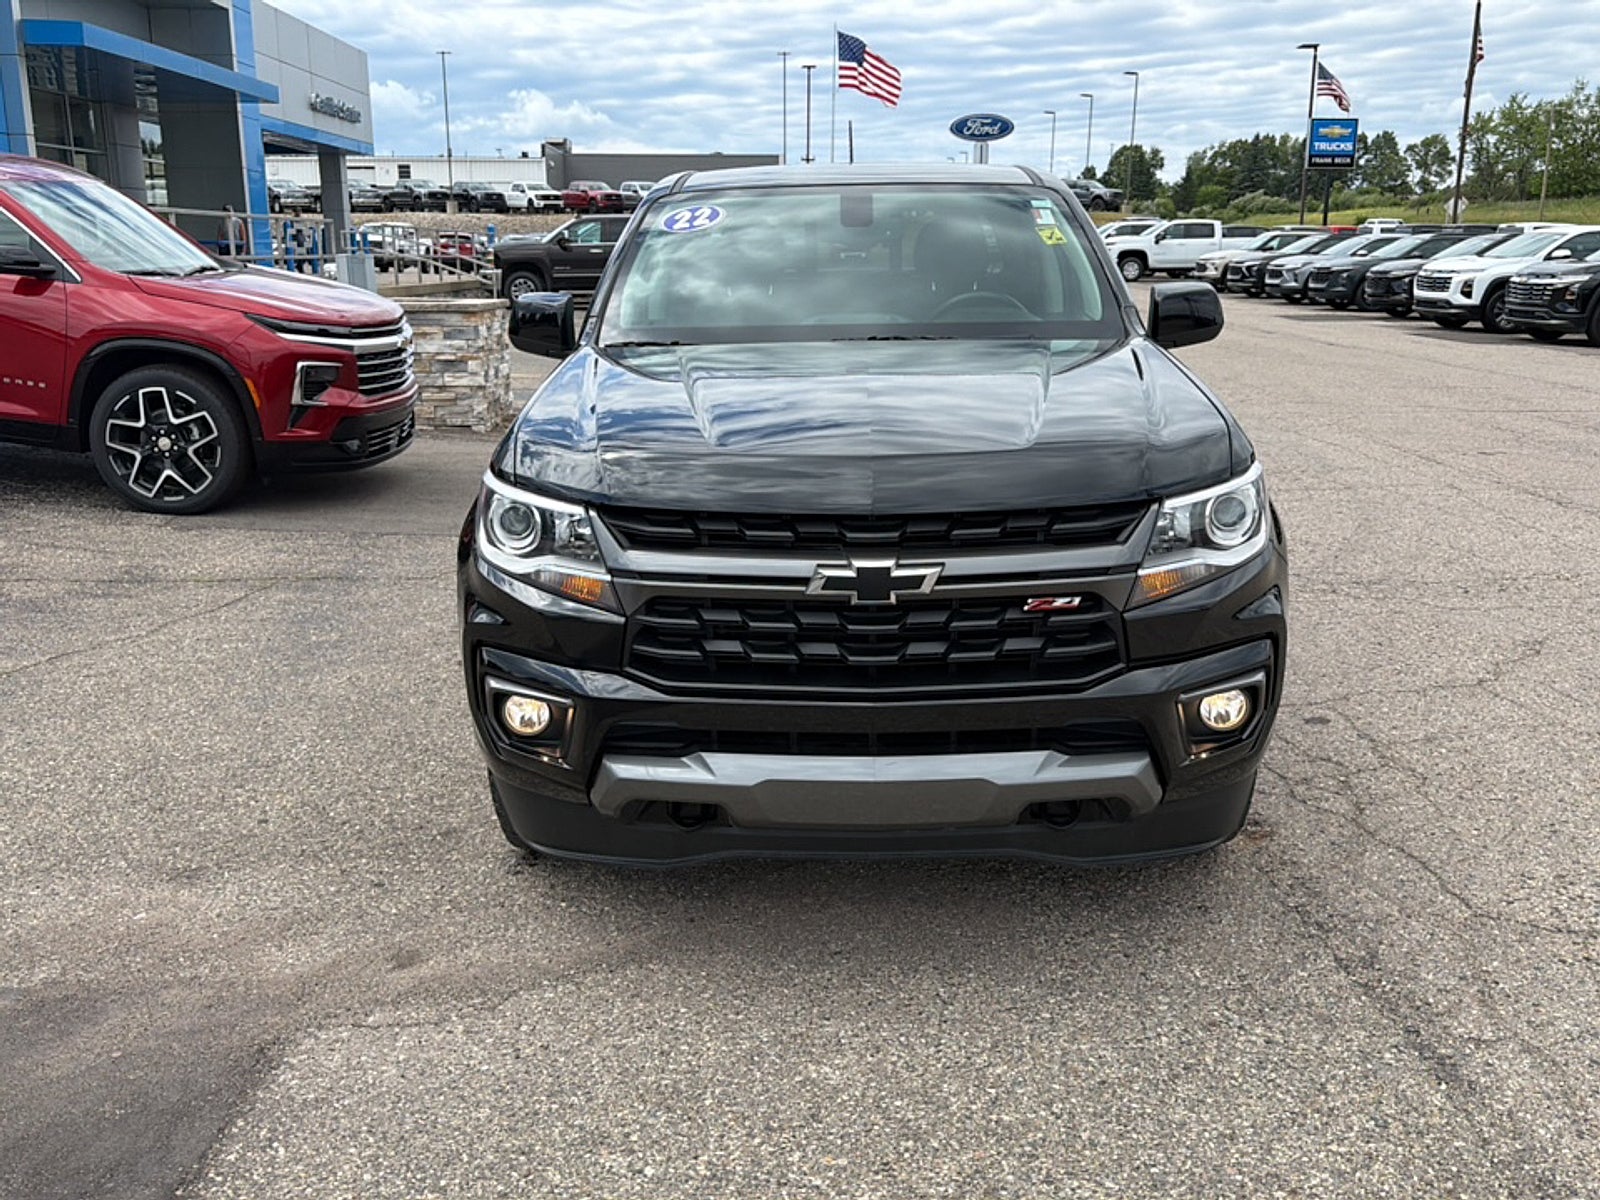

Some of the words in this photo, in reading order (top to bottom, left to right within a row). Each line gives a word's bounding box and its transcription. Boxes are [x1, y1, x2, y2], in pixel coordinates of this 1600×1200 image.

[963, 118, 1002, 135] Ford
[1313, 141, 1354, 151] TRUCKS
[672, 206, 712, 230] 22
